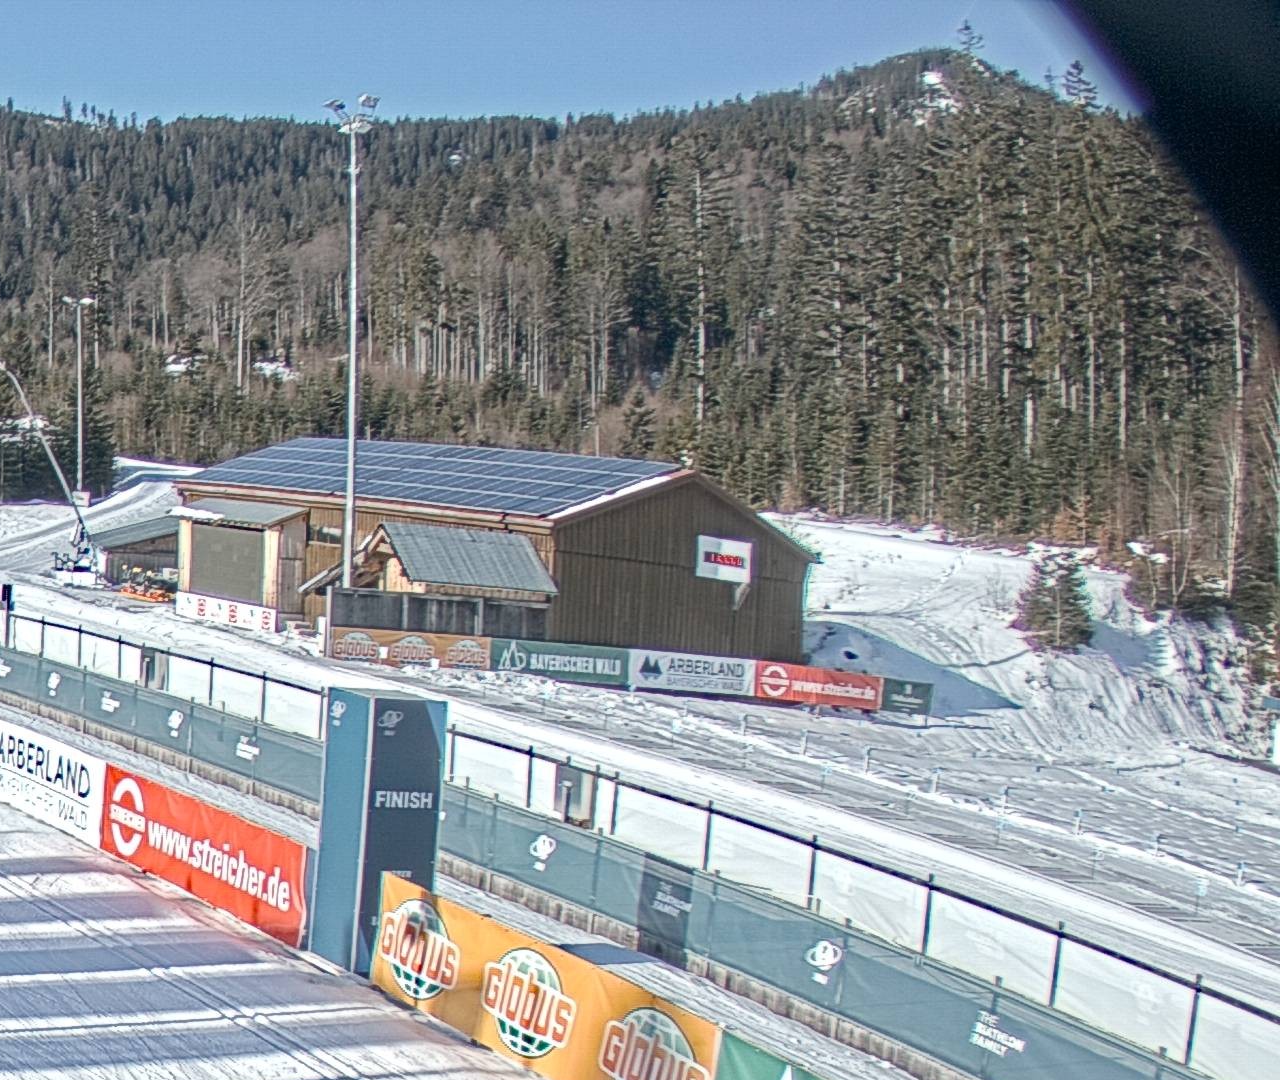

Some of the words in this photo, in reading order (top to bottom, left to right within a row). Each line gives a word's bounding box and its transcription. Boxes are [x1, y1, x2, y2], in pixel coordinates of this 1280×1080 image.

[529, 653, 594, 673] BAYERISCHER
[596, 658, 621, 675] WALD
[666, 658, 745, 677] ARBERLAND
[375, 791, 434, 809] FINISH
[147, 820, 290, 912] www.streicher.de
